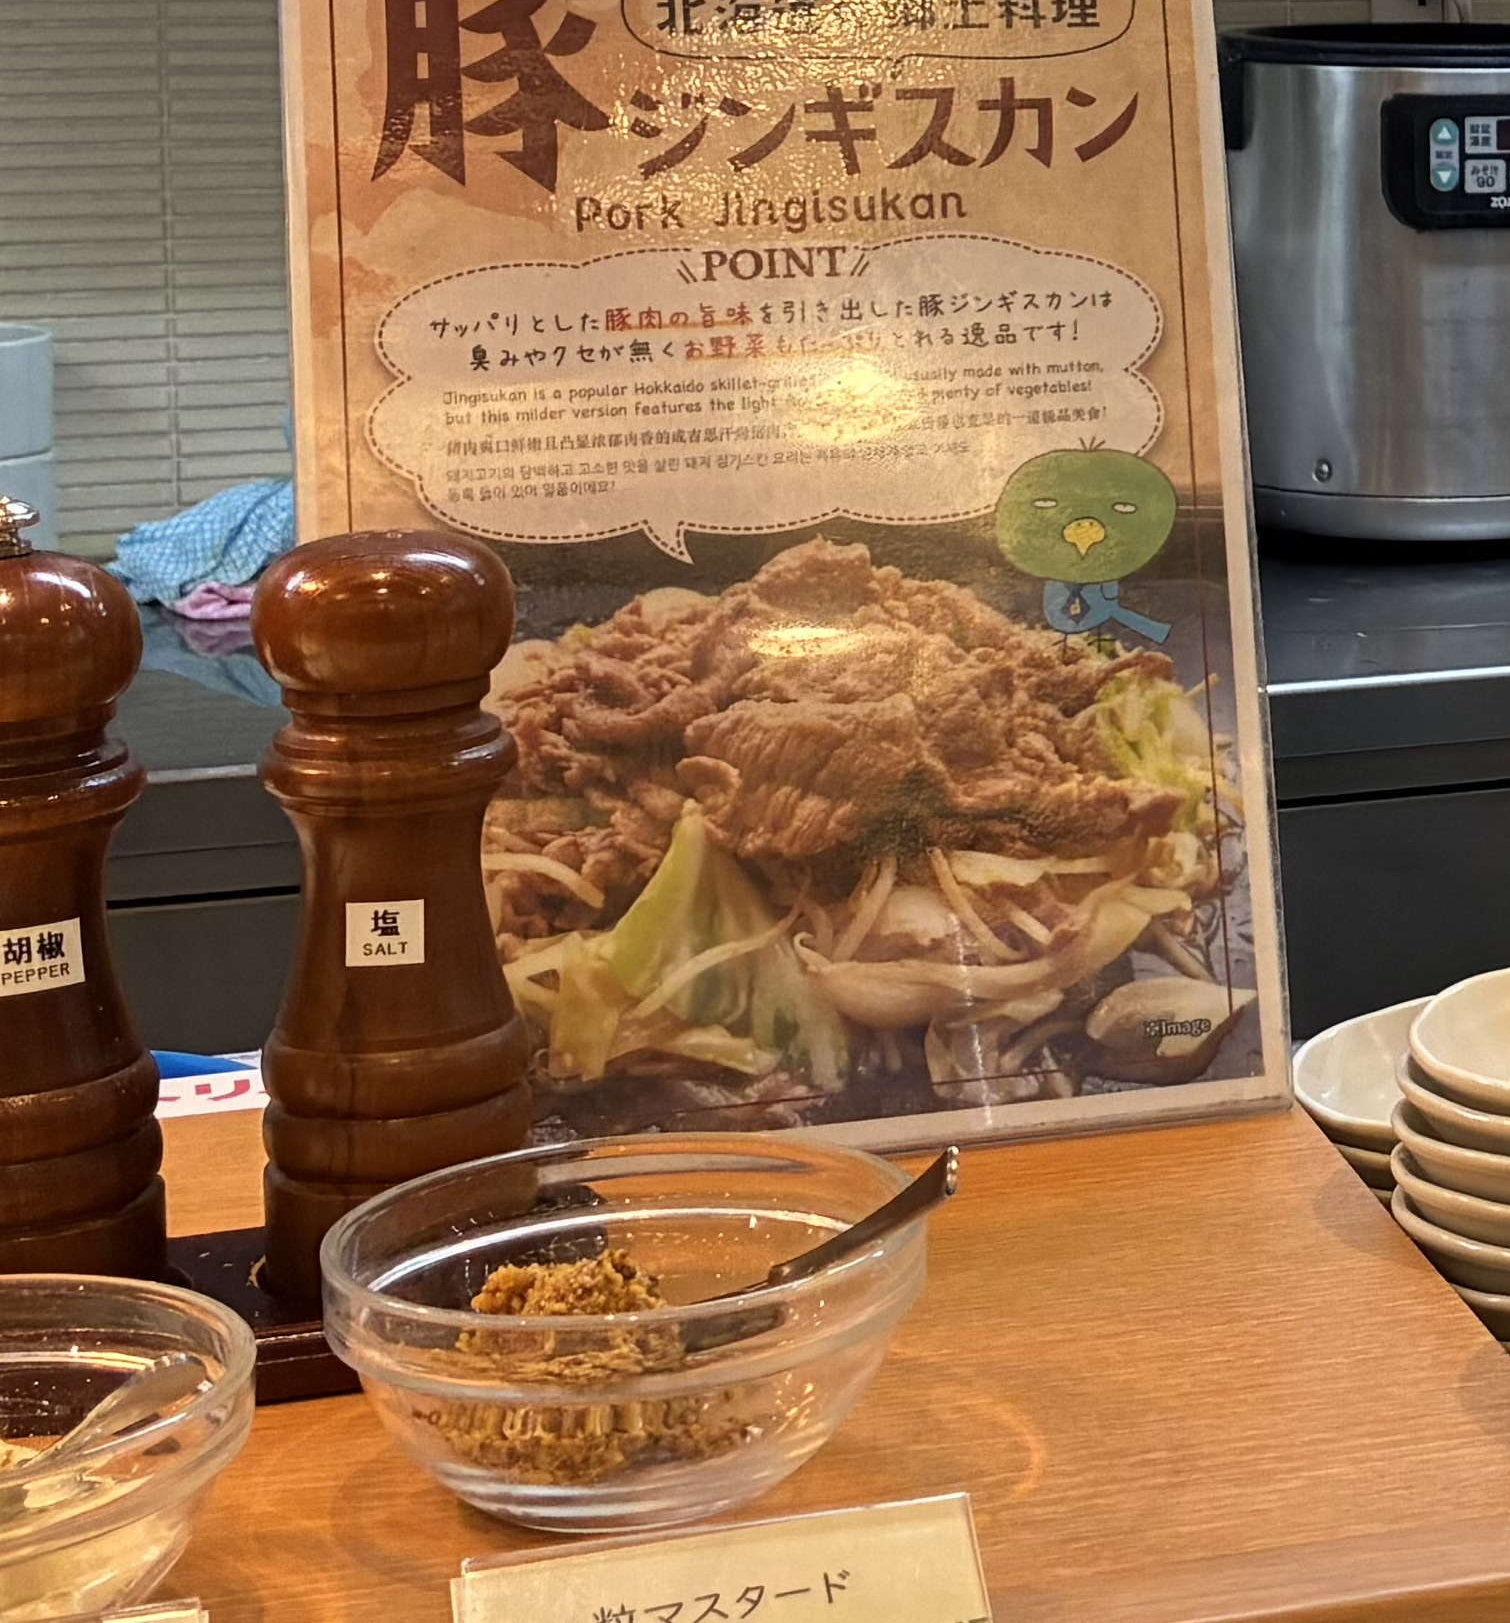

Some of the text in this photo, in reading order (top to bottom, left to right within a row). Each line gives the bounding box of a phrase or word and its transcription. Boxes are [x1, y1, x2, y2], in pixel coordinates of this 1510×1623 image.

[576, 186, 967, 233] Pork Jingisukan
[702, 246, 846, 282] POINT
[963, 363, 1002, 378] made
[1008, 361, 1041, 376] with
[443, 388, 527, 409] Jingisukan
[569, 383, 628, 402] popular
[634, 379, 704, 395] Hokkaido
[985, 382, 1001, 396] of
[445, 410, 472, 426] but
[481, 408, 510, 424] this
[516, 405, 566, 422] milder
[572, 403, 627, 419] version
[635, 399, 702, 416] features
[710, 396, 735, 412] the
[370, 909, 400, 937] 塩
[2, 931, 65, 965] 胡椒
[362, 941, 408, 956] SALT
[1, 962, 70, 985] PEPPER
